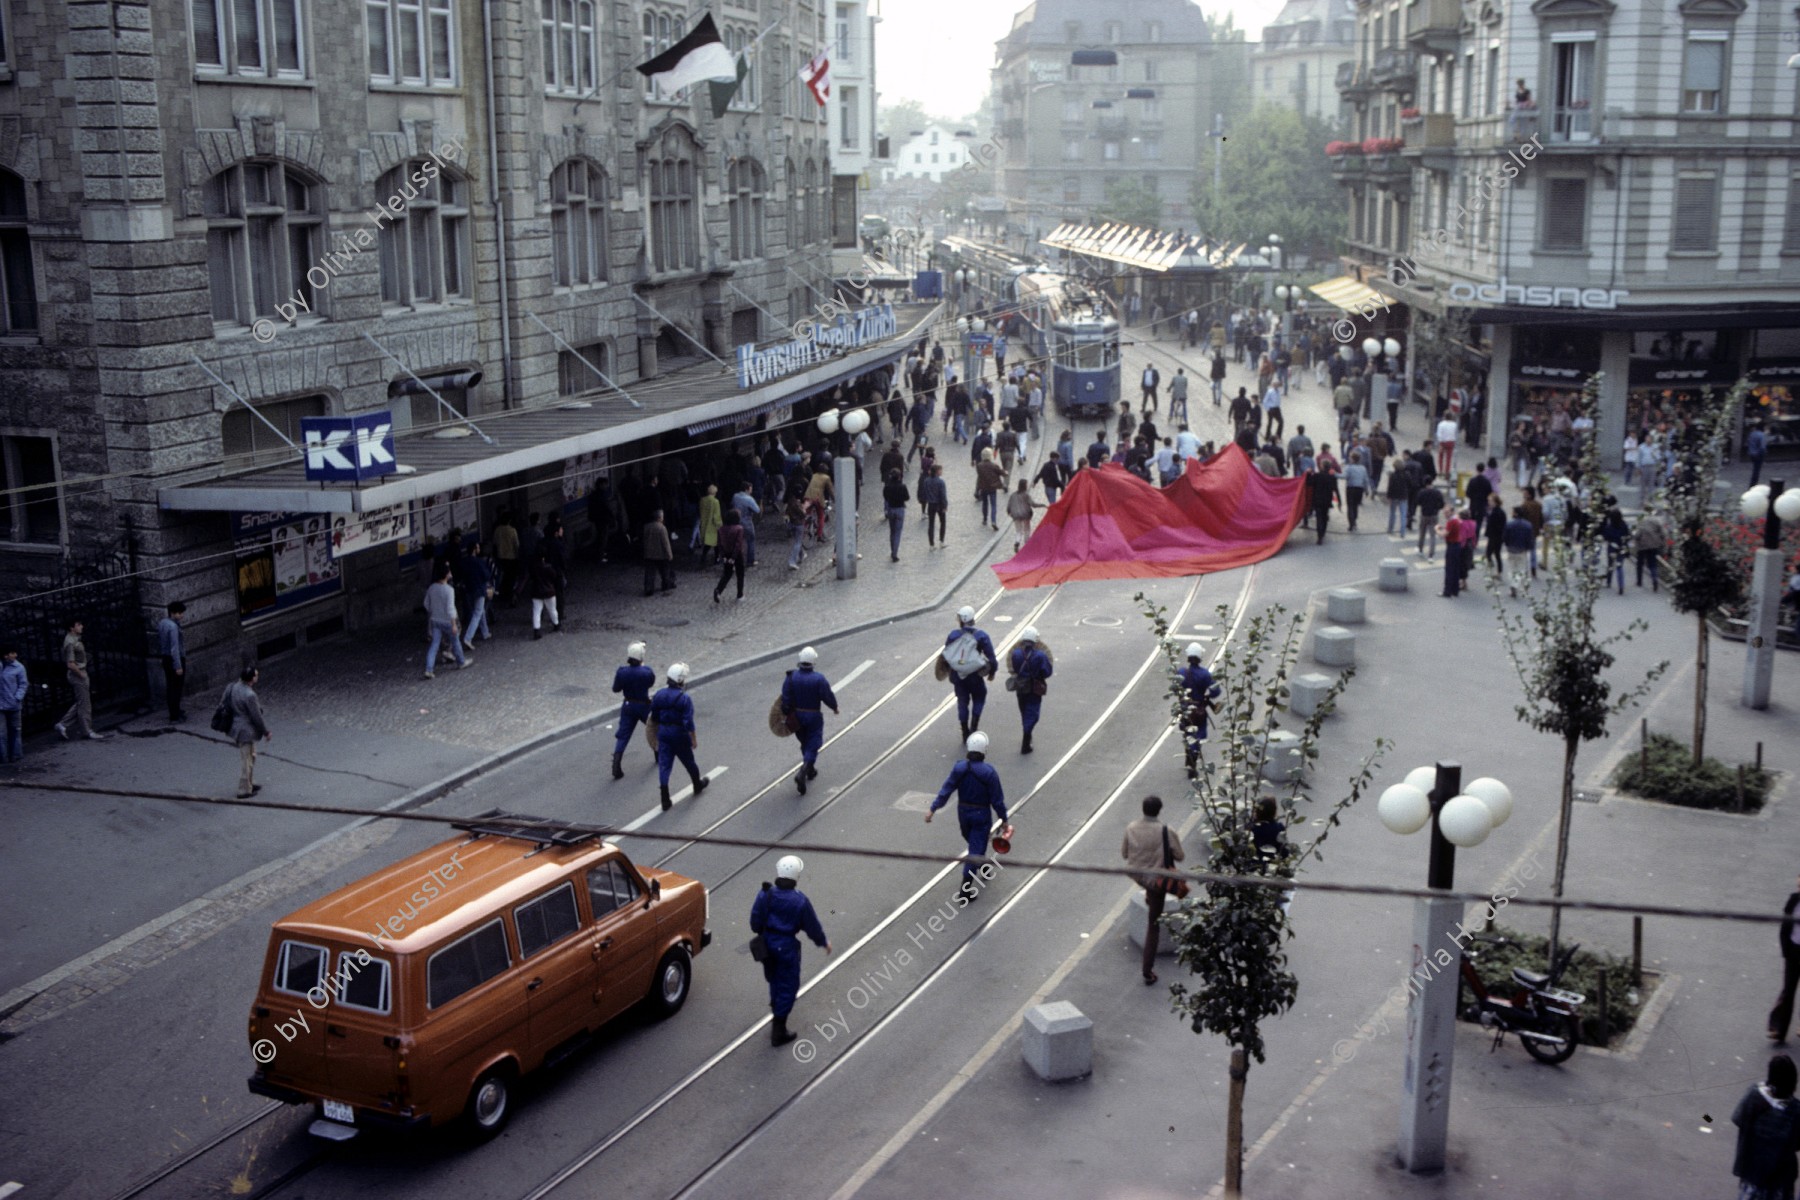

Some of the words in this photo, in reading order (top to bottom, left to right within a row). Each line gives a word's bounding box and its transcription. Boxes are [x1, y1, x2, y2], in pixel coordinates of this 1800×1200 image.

[1450, 276, 1630, 309] ochsner
[738, 335, 812, 389] Konsum
[856, 302, 898, 346] Zürich
